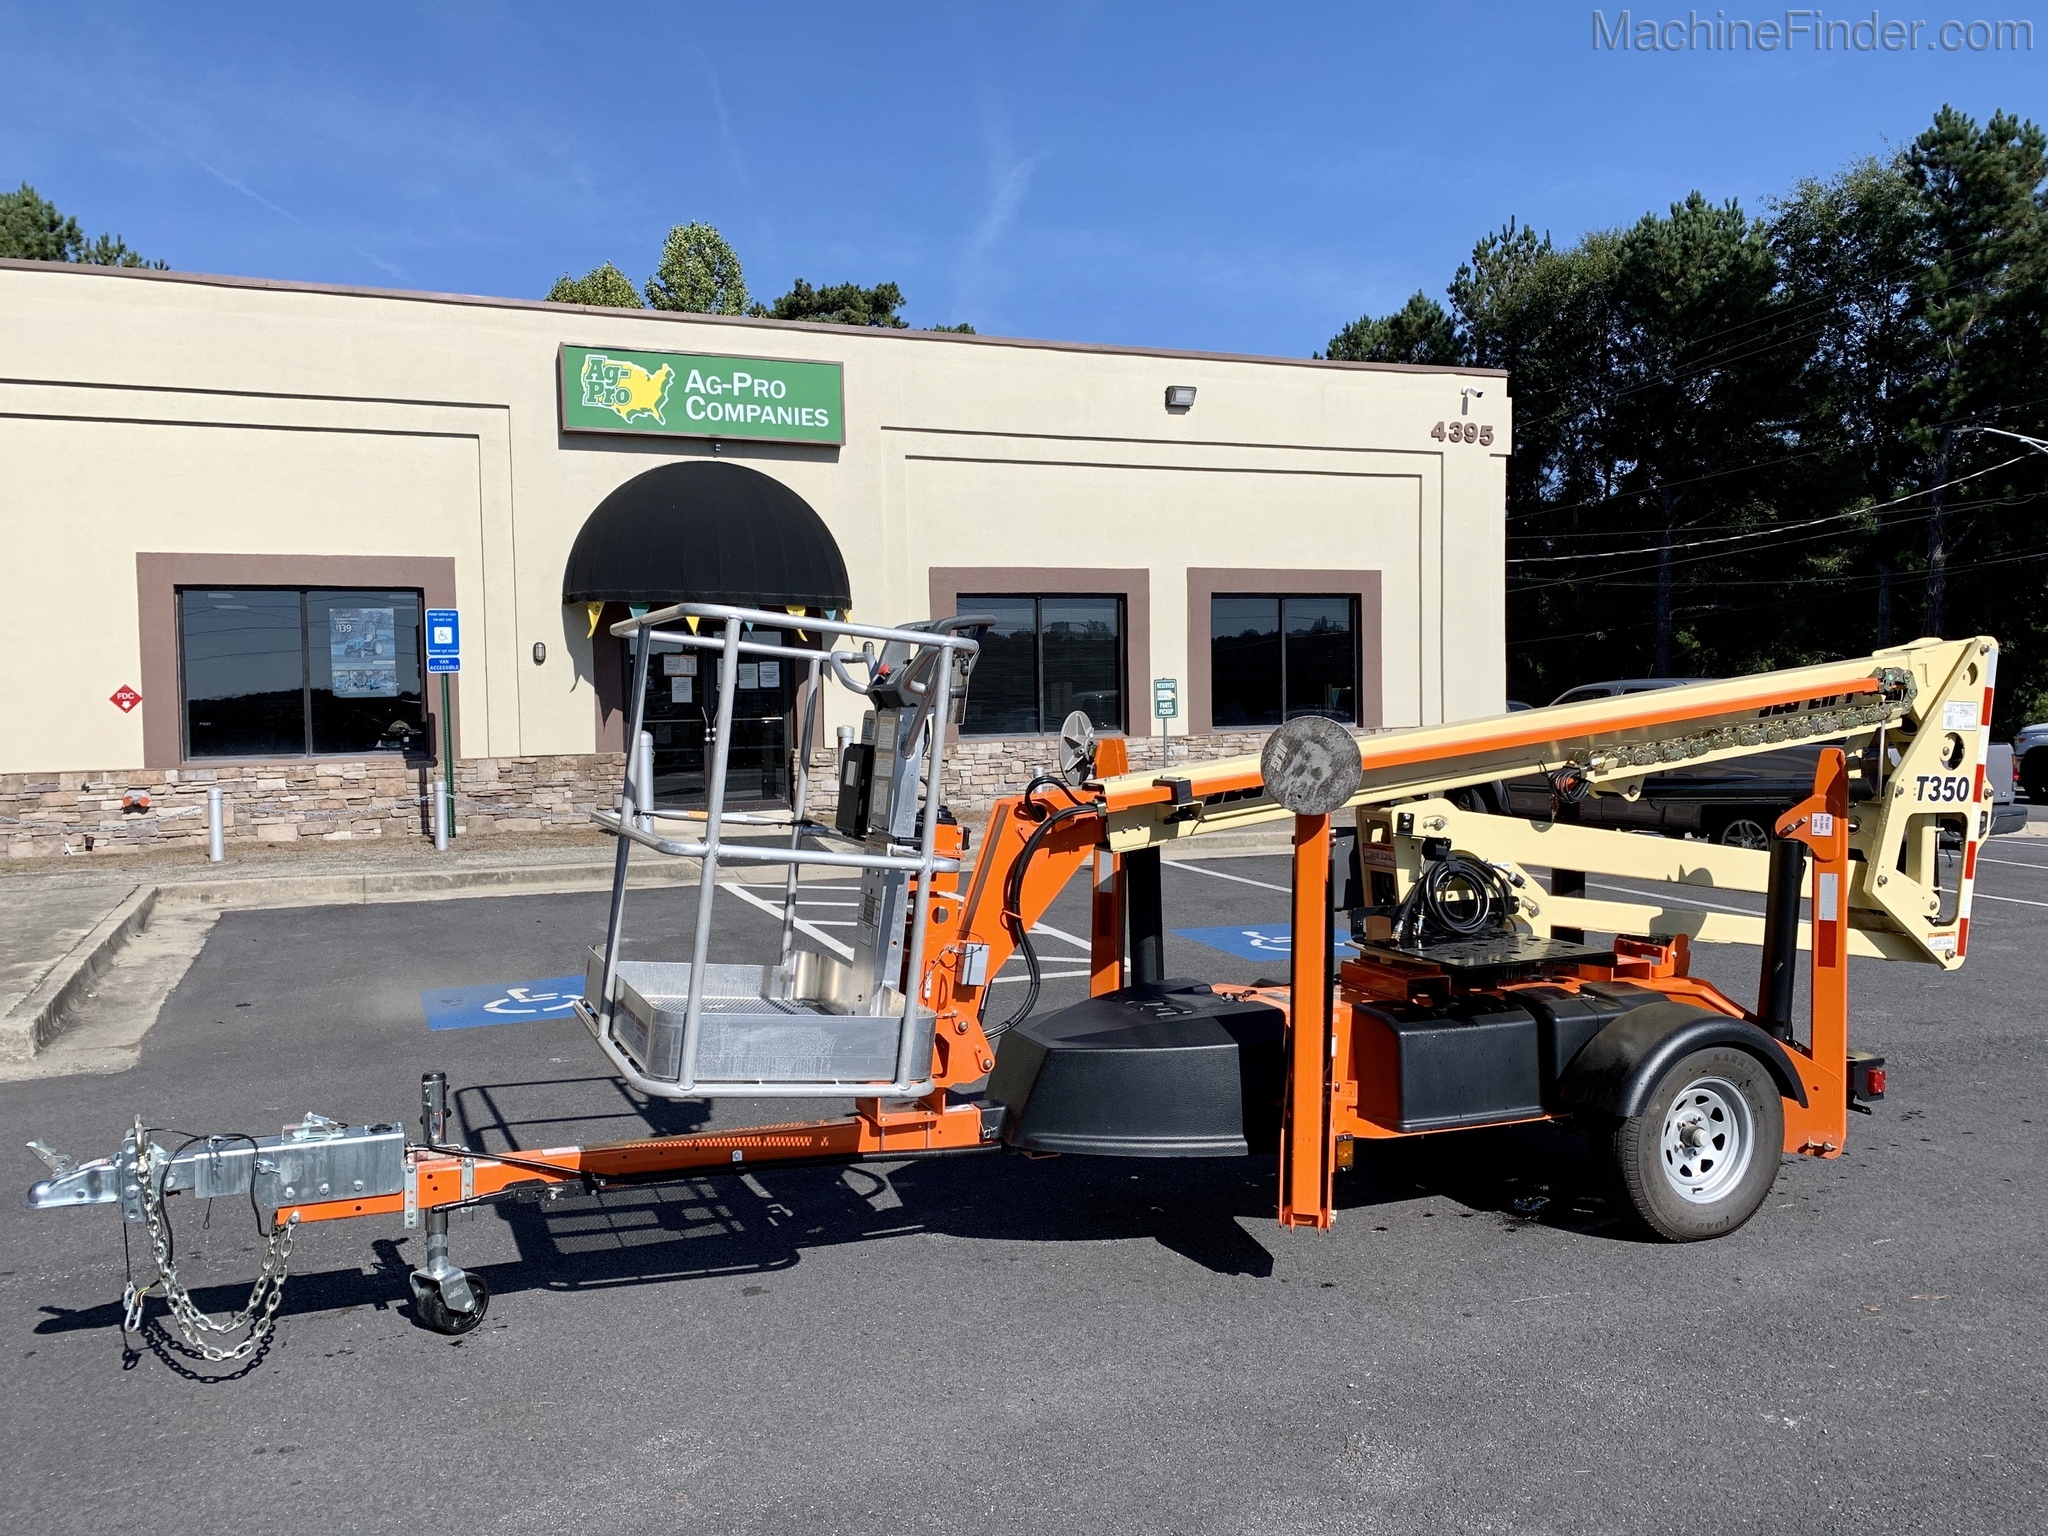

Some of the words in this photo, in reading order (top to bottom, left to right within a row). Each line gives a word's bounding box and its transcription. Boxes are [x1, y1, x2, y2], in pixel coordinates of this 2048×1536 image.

[583, 380, 632, 406] Pro
[1431, 421, 1494, 446] 4395
[335, 624, 352, 633] $139
[116, 692, 135, 700] FDC
[1915, 776, 1970, 802] T350
